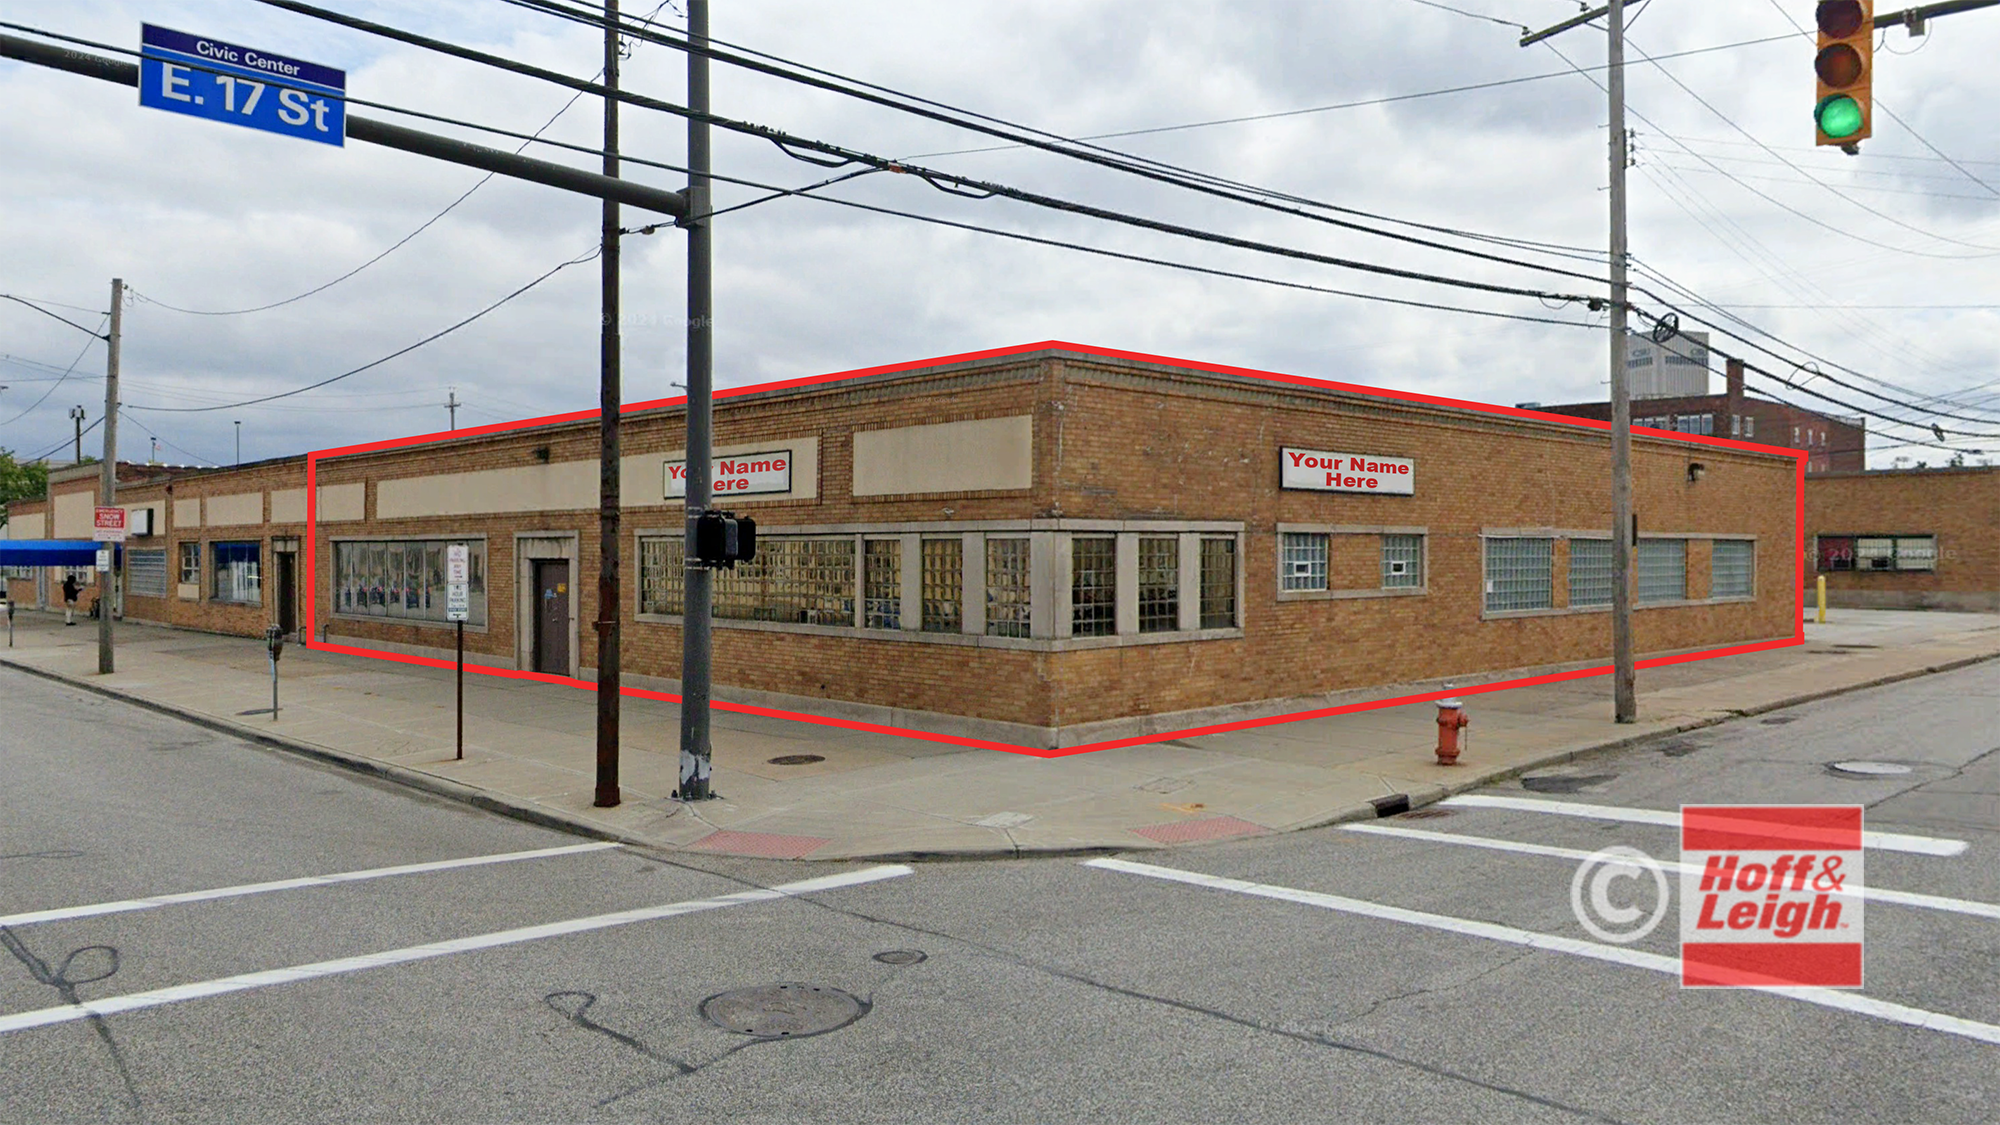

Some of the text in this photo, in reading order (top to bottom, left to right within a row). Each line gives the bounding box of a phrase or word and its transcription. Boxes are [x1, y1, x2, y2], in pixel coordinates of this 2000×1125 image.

[196, 40, 300, 76] Civic Center
[162, 62, 330, 132] E. 17 St
[720, 459, 786, 476] Name
[1288, 452, 1409, 475] Your Name
[712, 478, 750, 491] ere
[1325, 472, 1378, 488] Here
